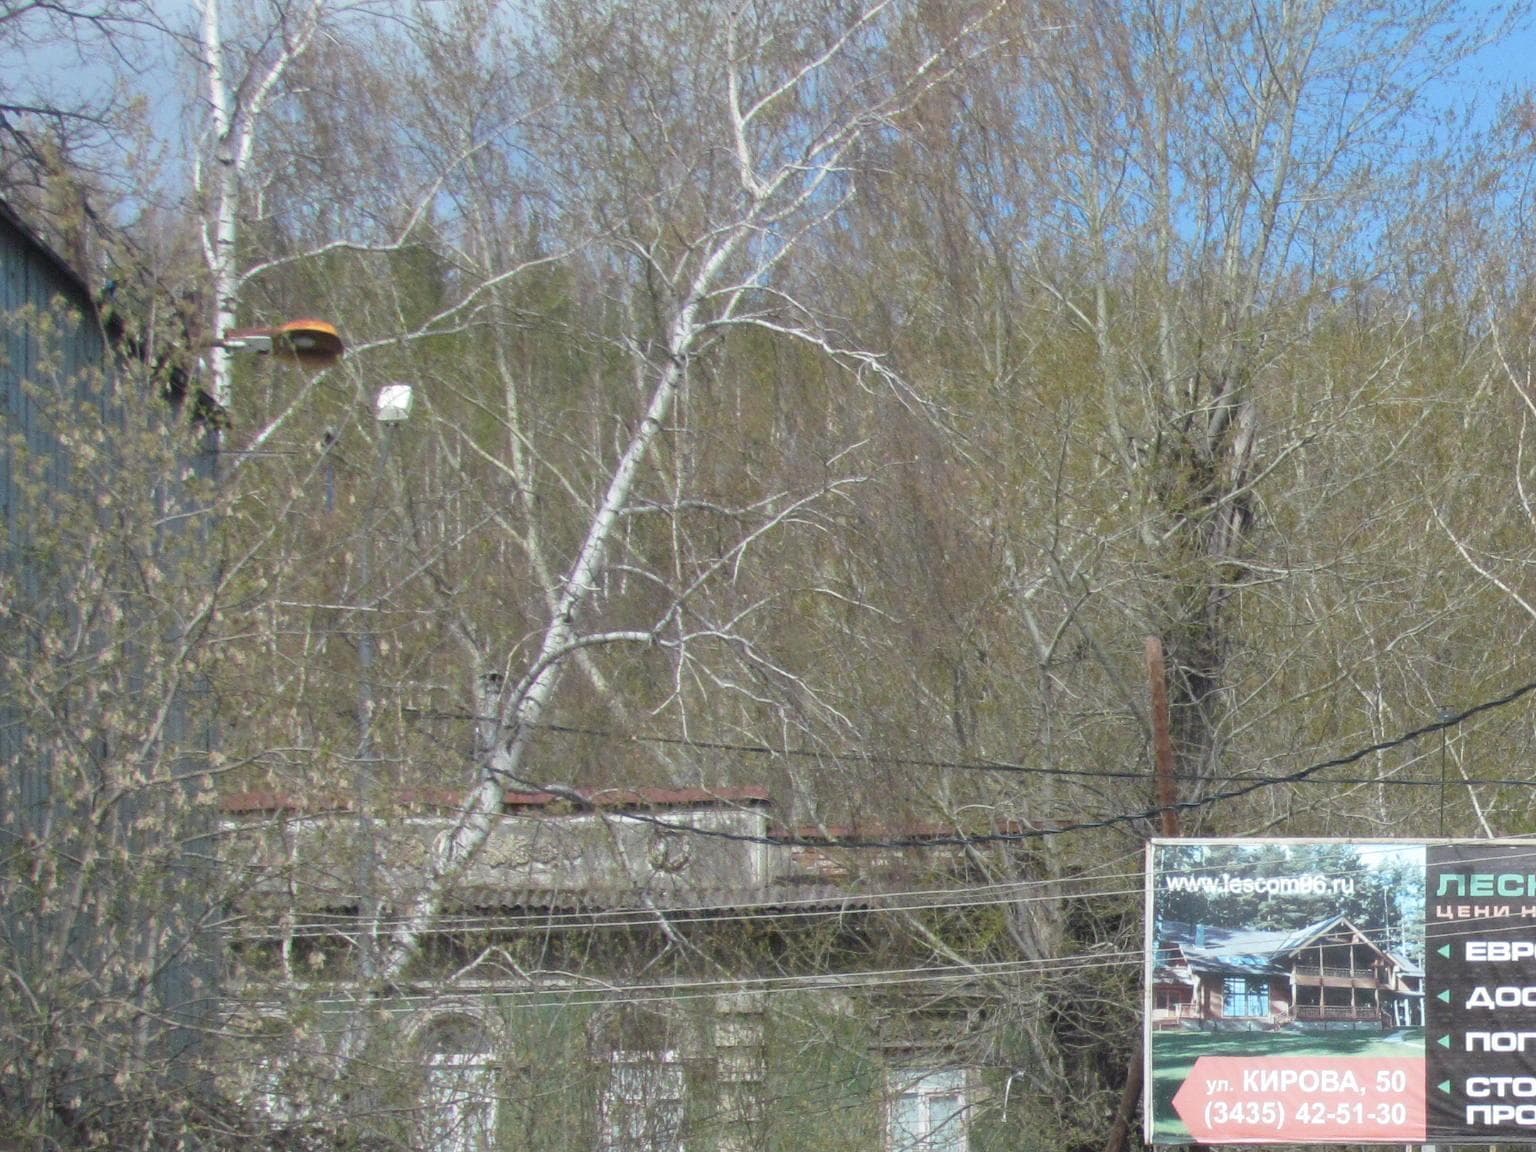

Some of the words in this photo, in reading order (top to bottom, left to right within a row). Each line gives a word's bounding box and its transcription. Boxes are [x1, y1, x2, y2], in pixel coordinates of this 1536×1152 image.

[1437, 905, 1509, 919] ЦЕНИ
[1206, 1079, 1234, 1096] ул.
[1243, 1069, 1367, 1096] КИРОВА,
[1375, 1070, 1406, 1093] 50
[1204, 1101, 1286, 1129] (3435)
[1295, 1102, 1407, 1124] 42-51-30
